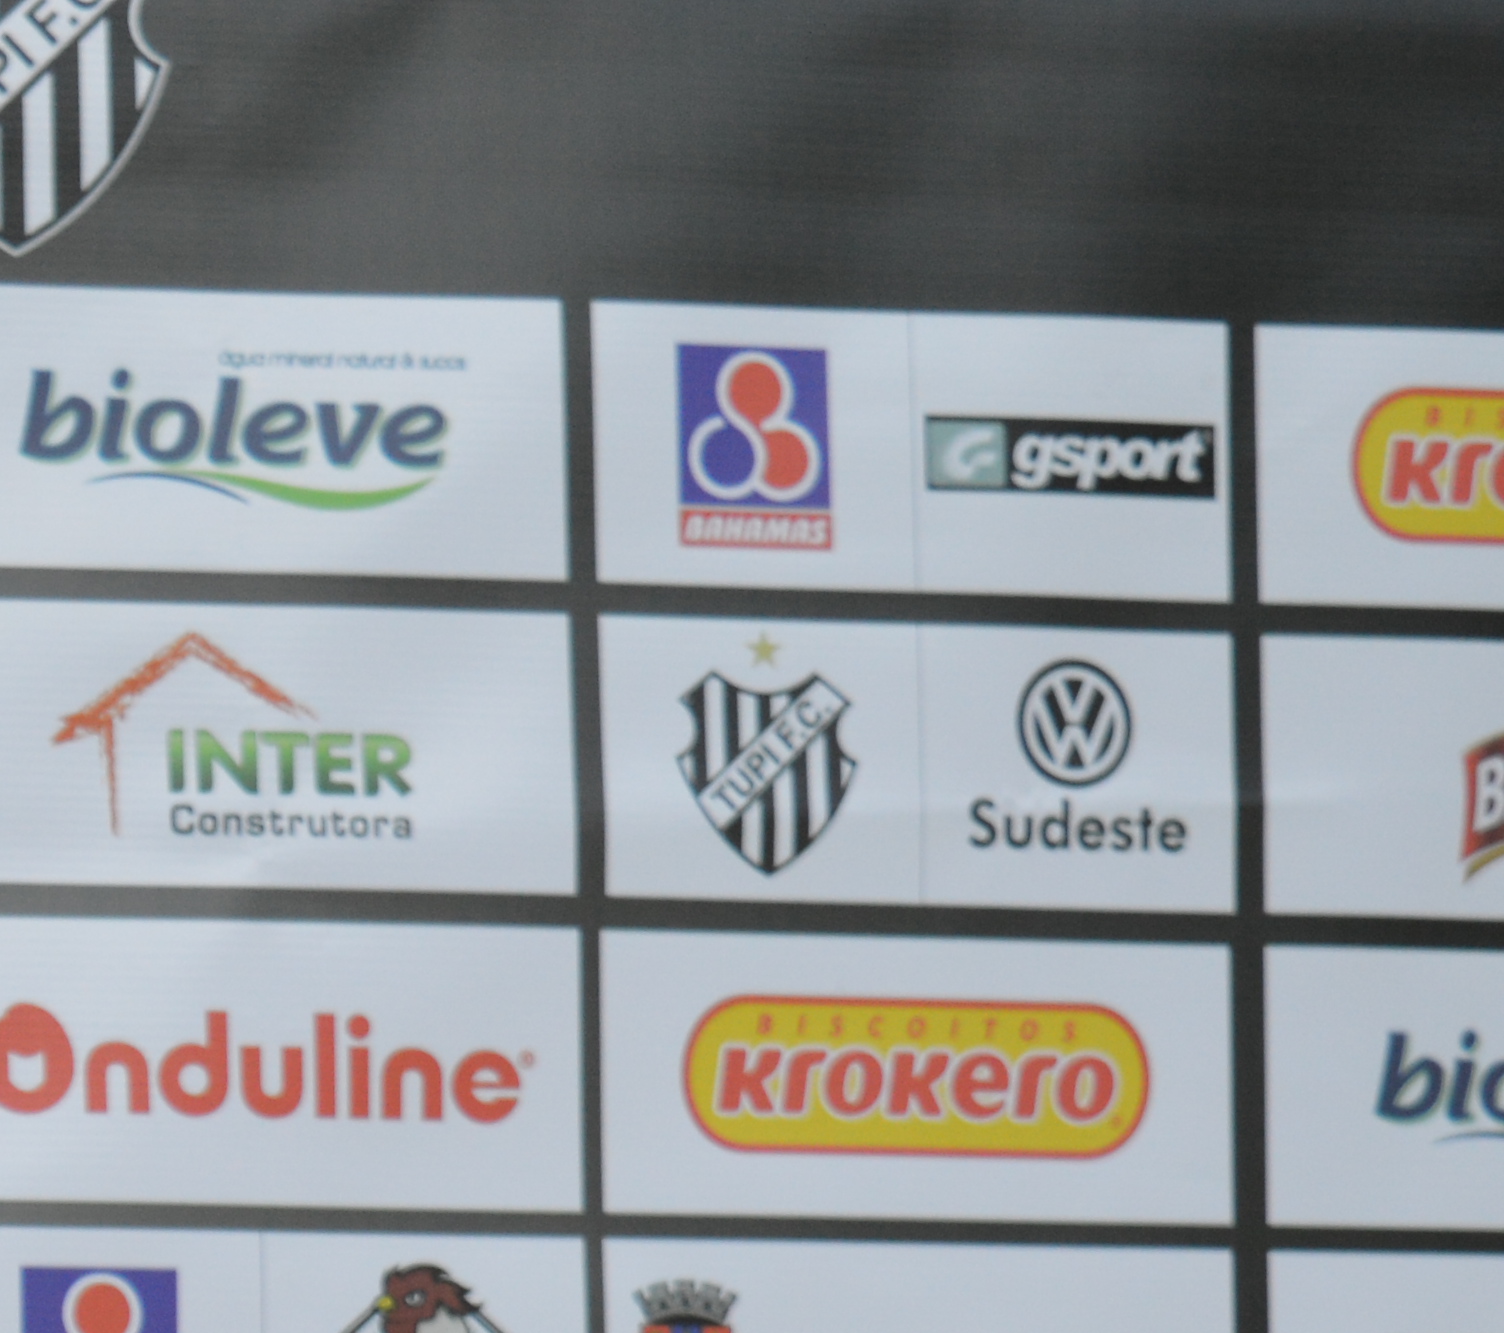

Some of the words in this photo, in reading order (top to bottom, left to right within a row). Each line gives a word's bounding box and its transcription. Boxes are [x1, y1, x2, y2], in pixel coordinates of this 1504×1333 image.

[20, 368, 448, 469] bioleve
[684, 514, 828, 544] BAHAMAS
[168, 728, 412, 797] INTER
[169, 803, 413, 840] Construtora
[969, 798, 1188, 853] Sudeste
[758, 1015, 1078, 1042] BISCOITOS
